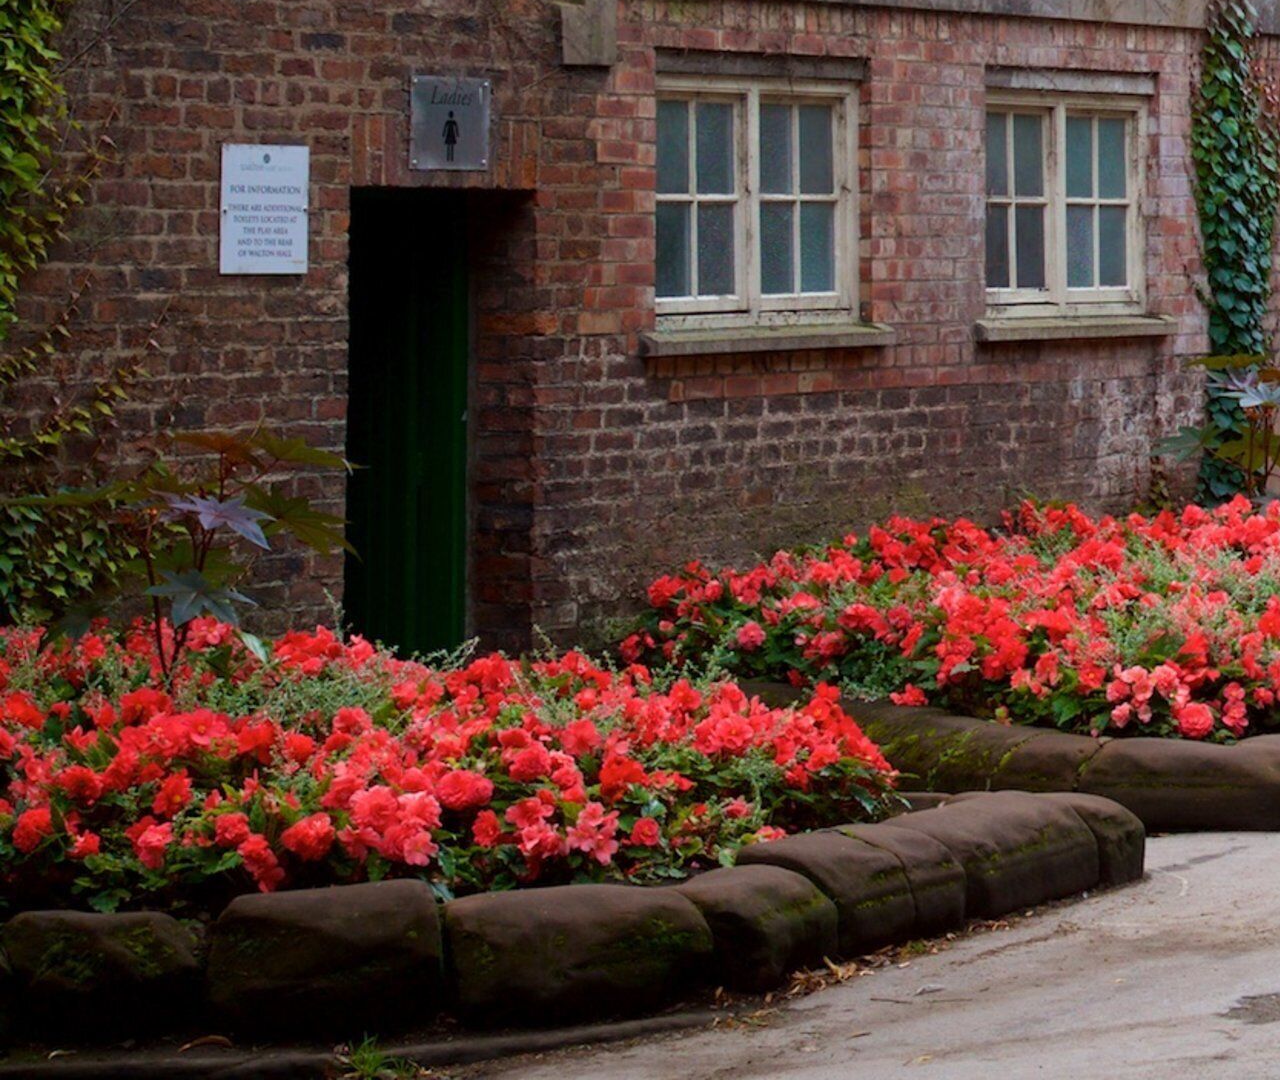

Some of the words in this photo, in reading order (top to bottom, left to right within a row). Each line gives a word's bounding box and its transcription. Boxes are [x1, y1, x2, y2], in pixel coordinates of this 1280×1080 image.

[431, 85, 473, 106] Ladies
[229, 184, 245, 193] FOR
[247, 185, 301, 194] INFORMATION
[228, 204, 248, 212] THERE
[250, 204, 262, 212] ARE
[263, 204, 302, 213] ADDITIONAL
[233, 215, 258, 223] TOILETS
[273, 227, 288, 235] AREA
[275, 250, 292, 258] HALL
